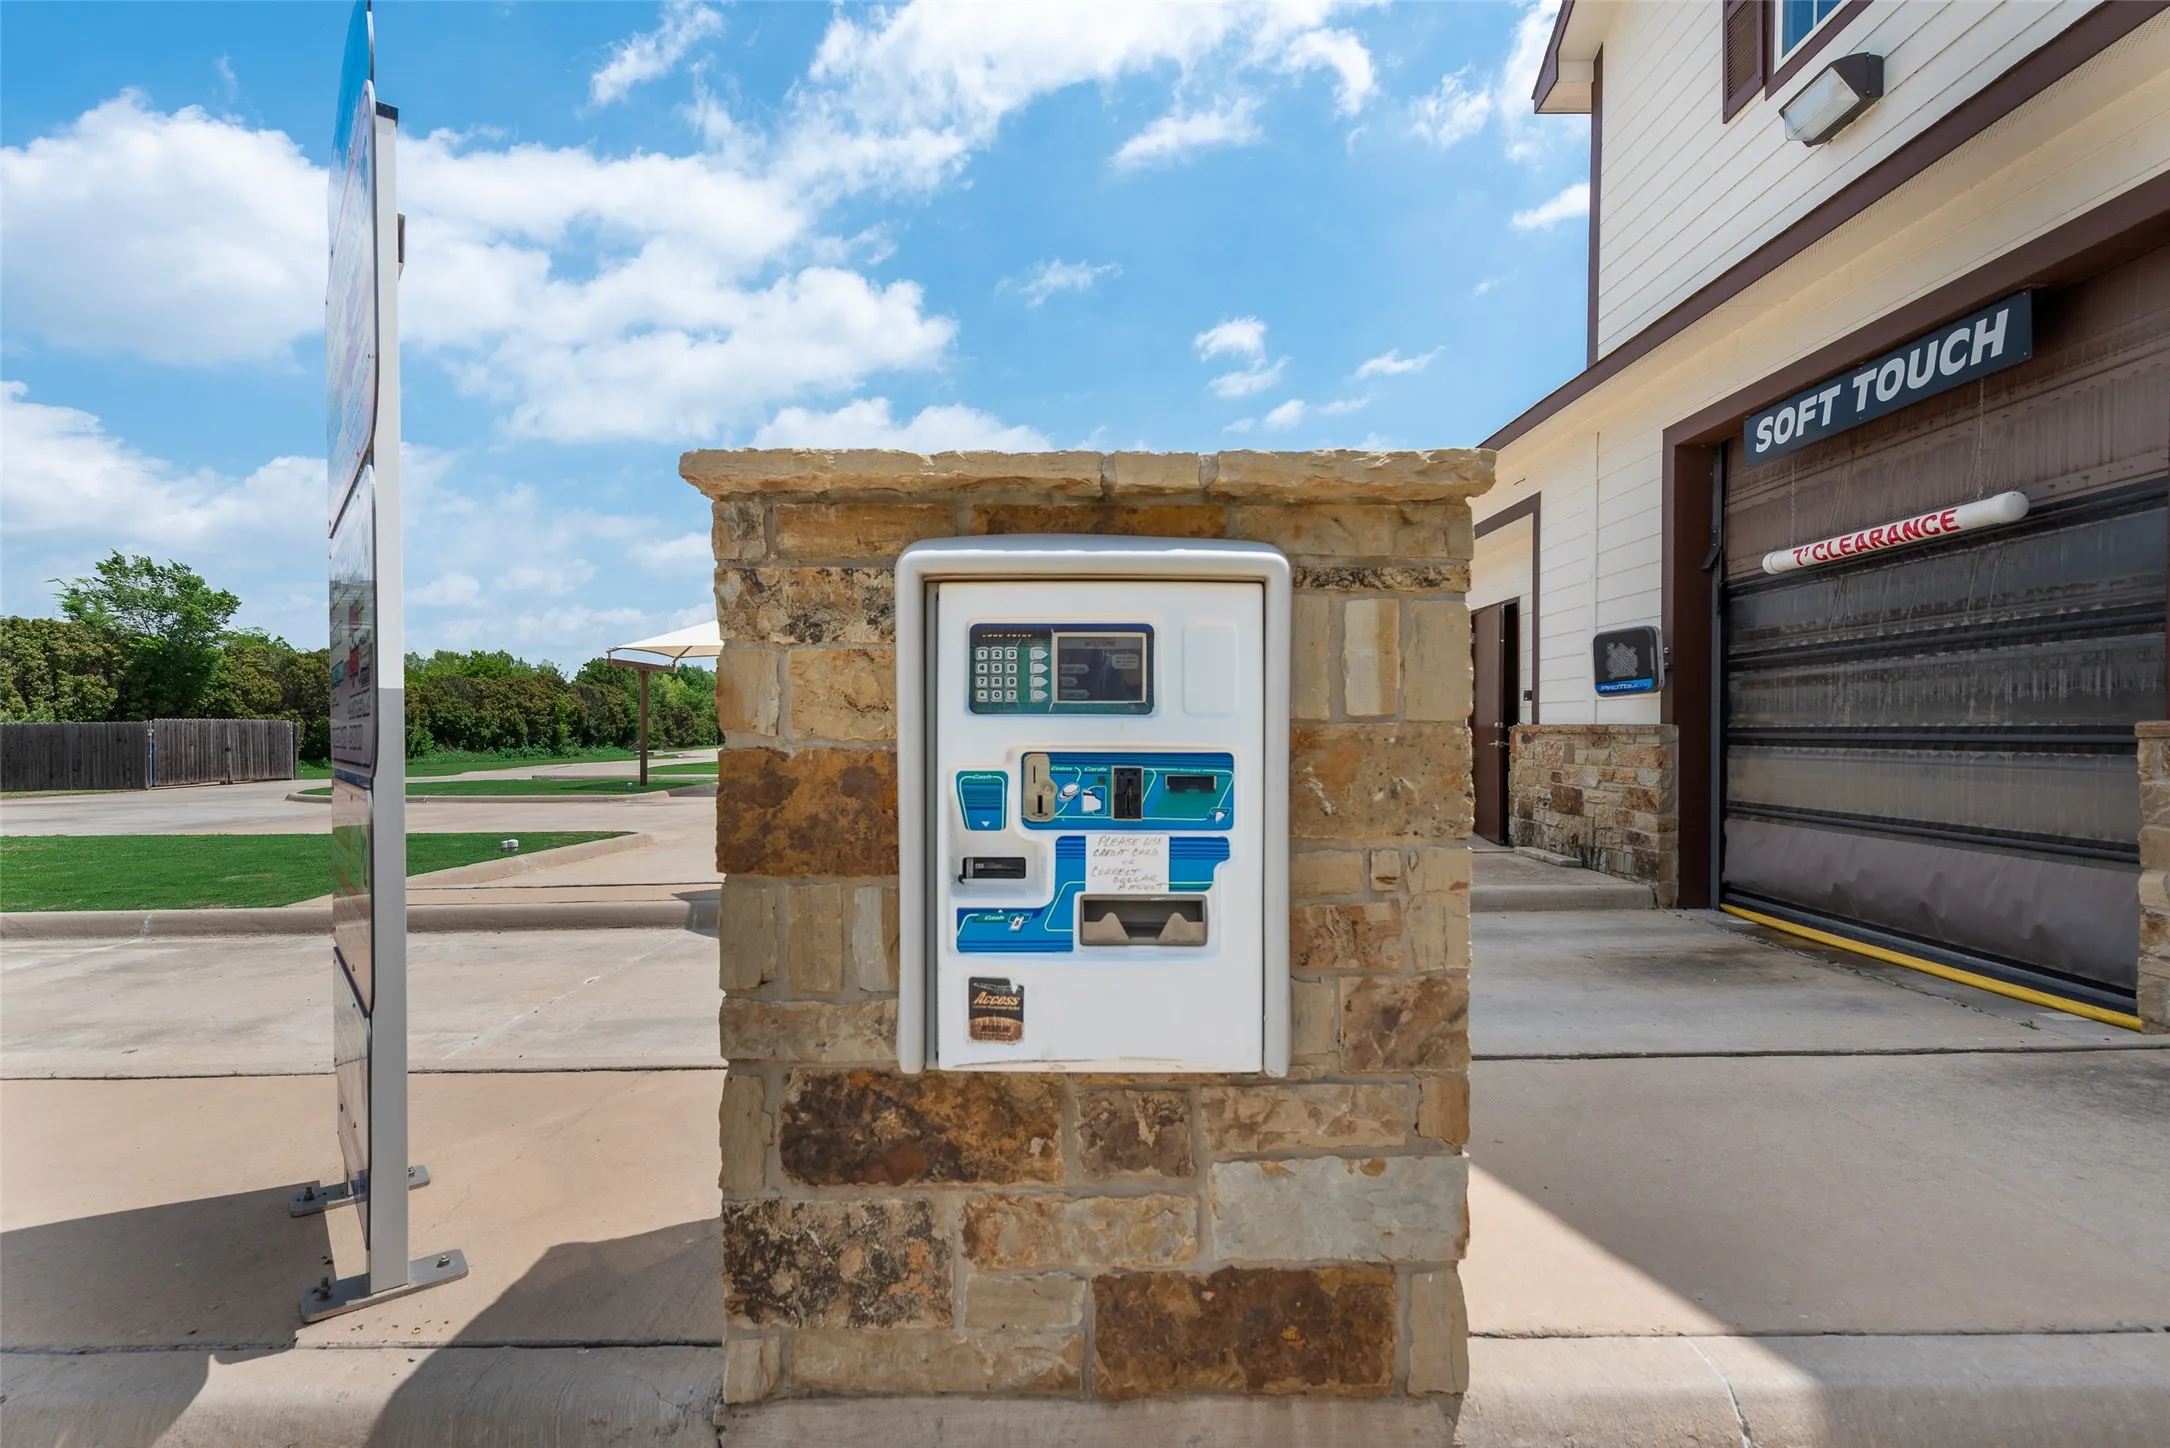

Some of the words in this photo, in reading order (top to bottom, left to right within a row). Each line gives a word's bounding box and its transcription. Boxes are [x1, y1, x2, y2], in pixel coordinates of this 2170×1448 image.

[1755, 383, 1841, 453] SOFT
[1852, 308, 2009, 413] TOUCH
[1812, 508, 1961, 562] CLEARANCE
[1098, 835, 1140, 847] PLEASE
[1143, 836, 1164, 846] USE
[1093, 848, 1130, 857] CREDIT
[1132, 848, 1159, 857] CARD
[1091, 866, 1142, 877] CORRECT
[1113, 874, 1157, 883] DOLLAR
[973, 991, 1020, 1006] Access
